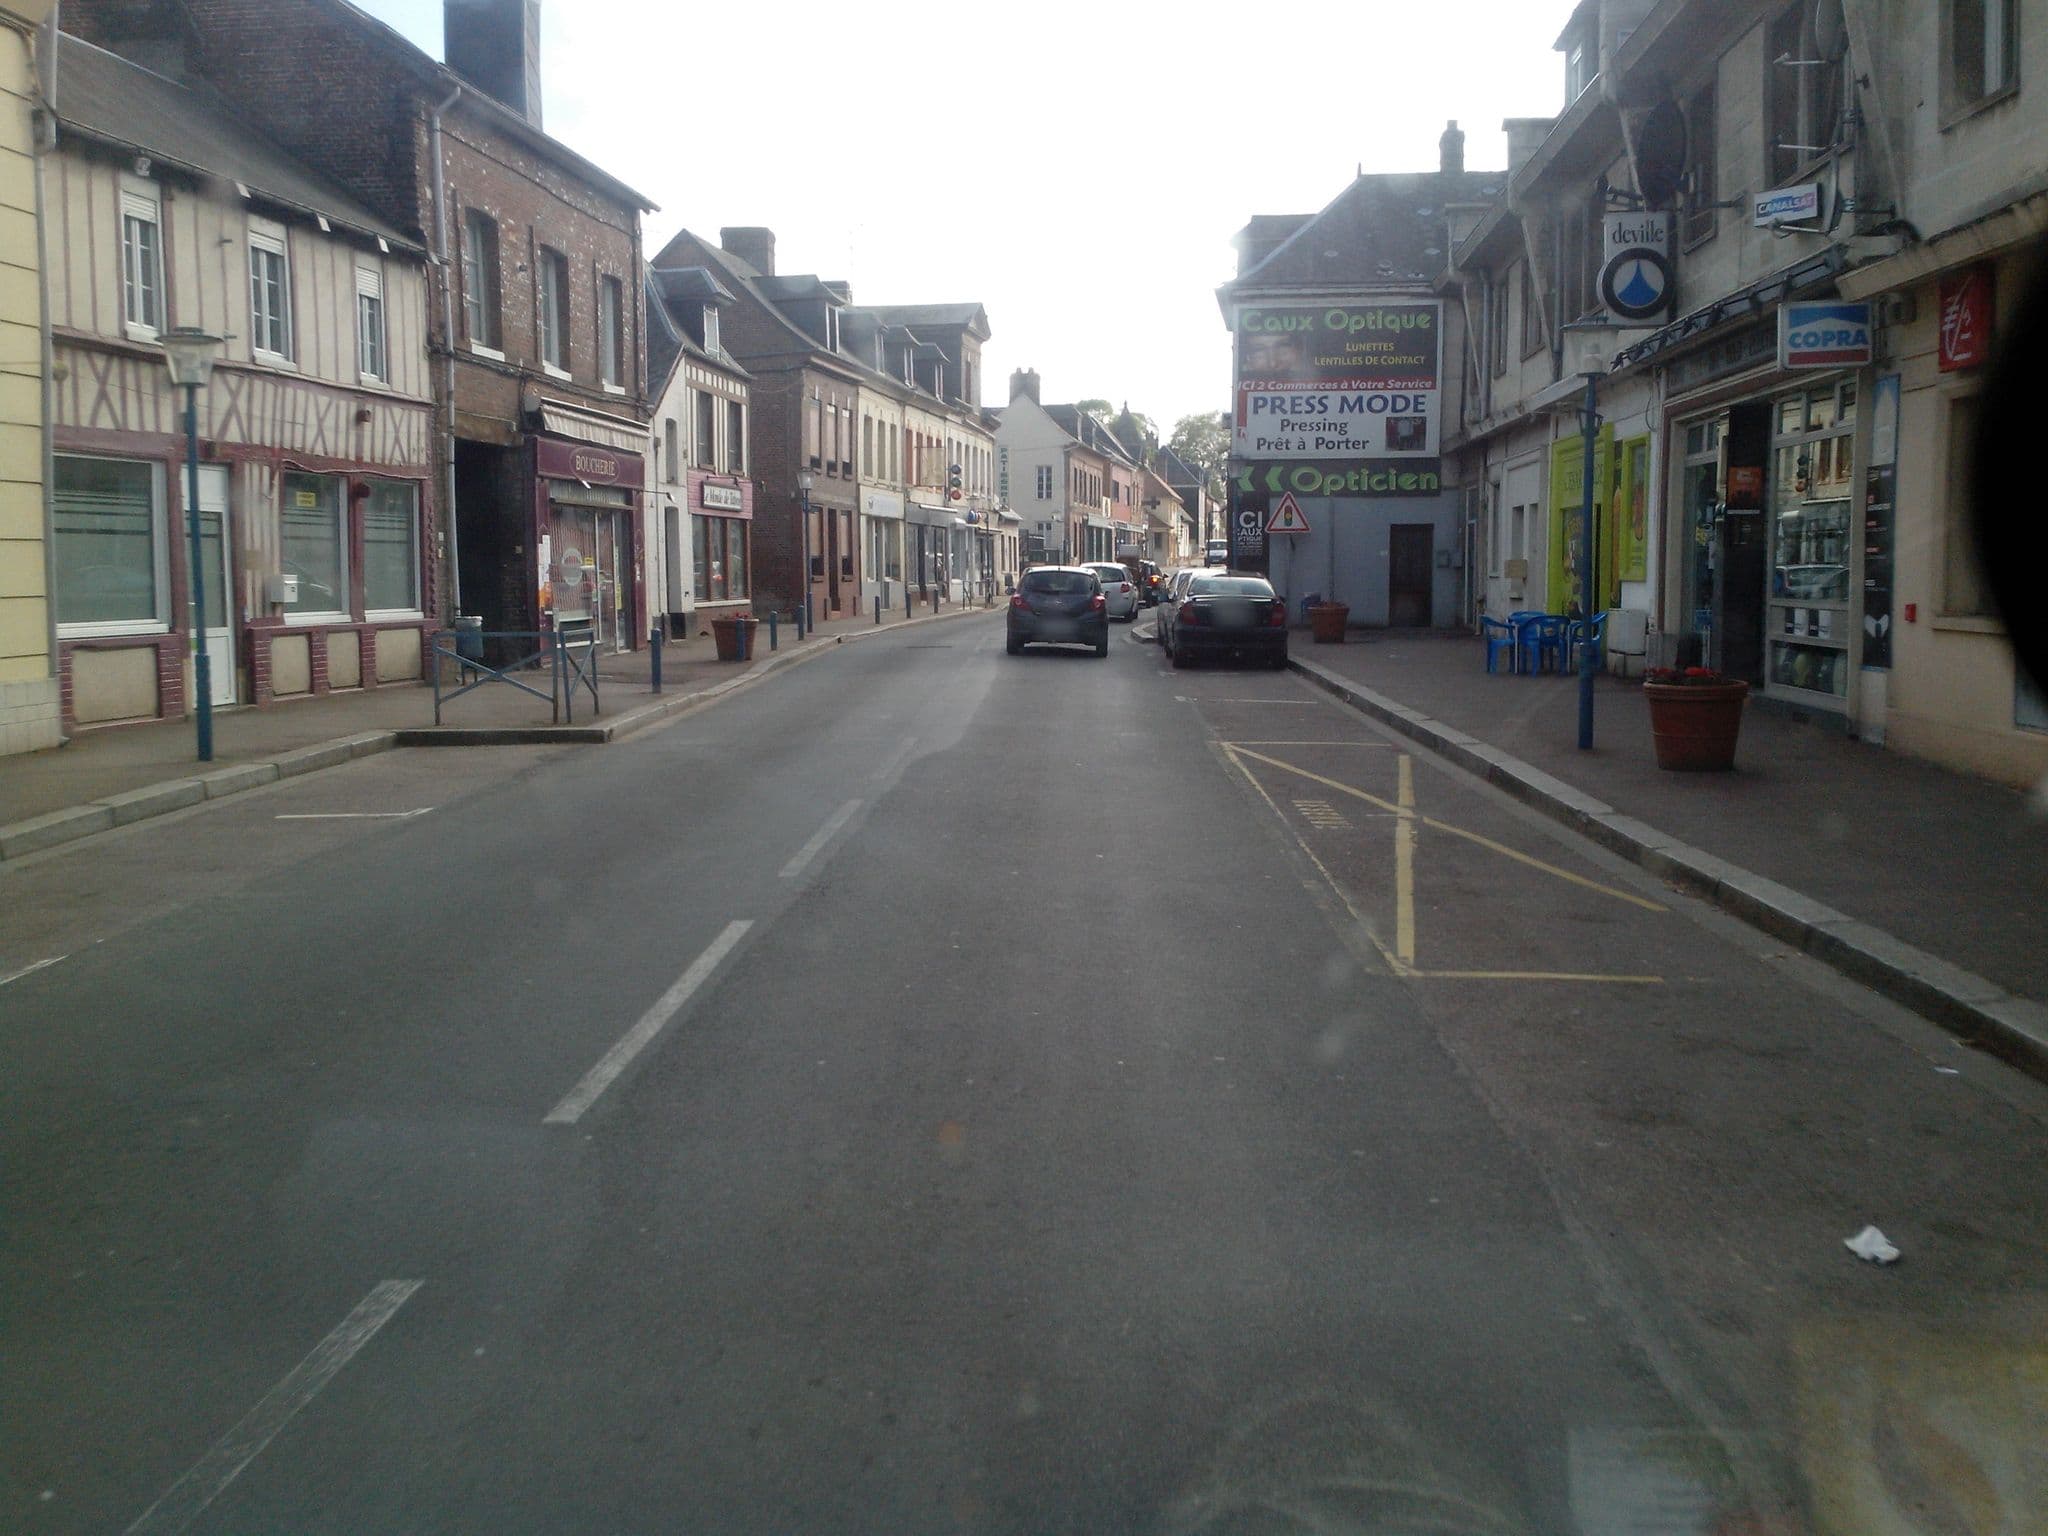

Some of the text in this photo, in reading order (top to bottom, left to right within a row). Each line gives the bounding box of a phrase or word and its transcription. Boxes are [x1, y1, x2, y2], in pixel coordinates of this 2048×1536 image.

[1612, 219, 1664, 245] deville
[1241, 308, 1432, 334] Caux Optique
[1345, 342, 1395, 351] LUNETTES
[1788, 328, 1869, 348] COPRA
[1314, 355, 1426, 366] LENTILLES DE CONTACT
[1256, 381, 1266, 390] 2
[1268, 380, 1338, 391] Commerces
[1341, 379, 1349, 389] à
[1351, 379, 1385, 390] Votre
[1387, 379, 1432, 389] Service
[1252, 393, 1427, 415] PRESS MODE
[1280, 418, 1348, 435] Pressing
[1256, 436, 1370, 451] Prêt à Porter
[575, 455, 615, 476] BOUCHERIE
[1290, 466, 1439, 496] Opticien
